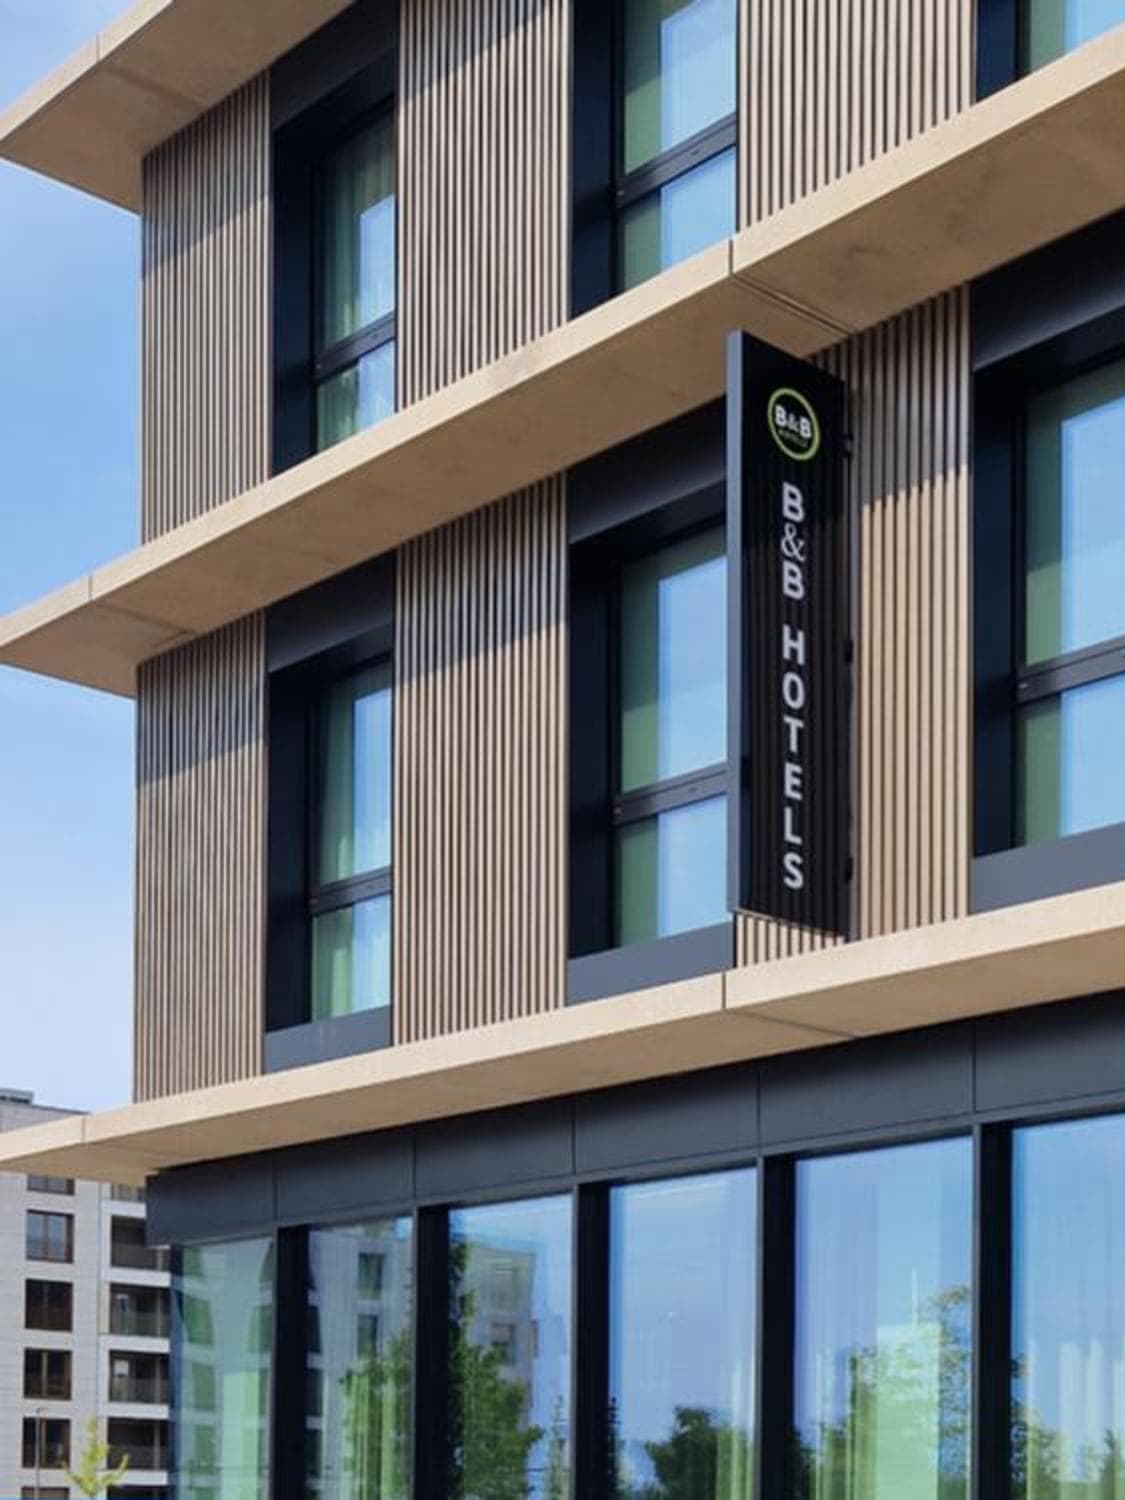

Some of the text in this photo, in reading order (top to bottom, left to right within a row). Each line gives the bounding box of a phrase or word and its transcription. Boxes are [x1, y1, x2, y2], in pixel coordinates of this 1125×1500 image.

[775, 404, 811, 439] B&B
[781, 481, 806, 889] B&B HOTELS
